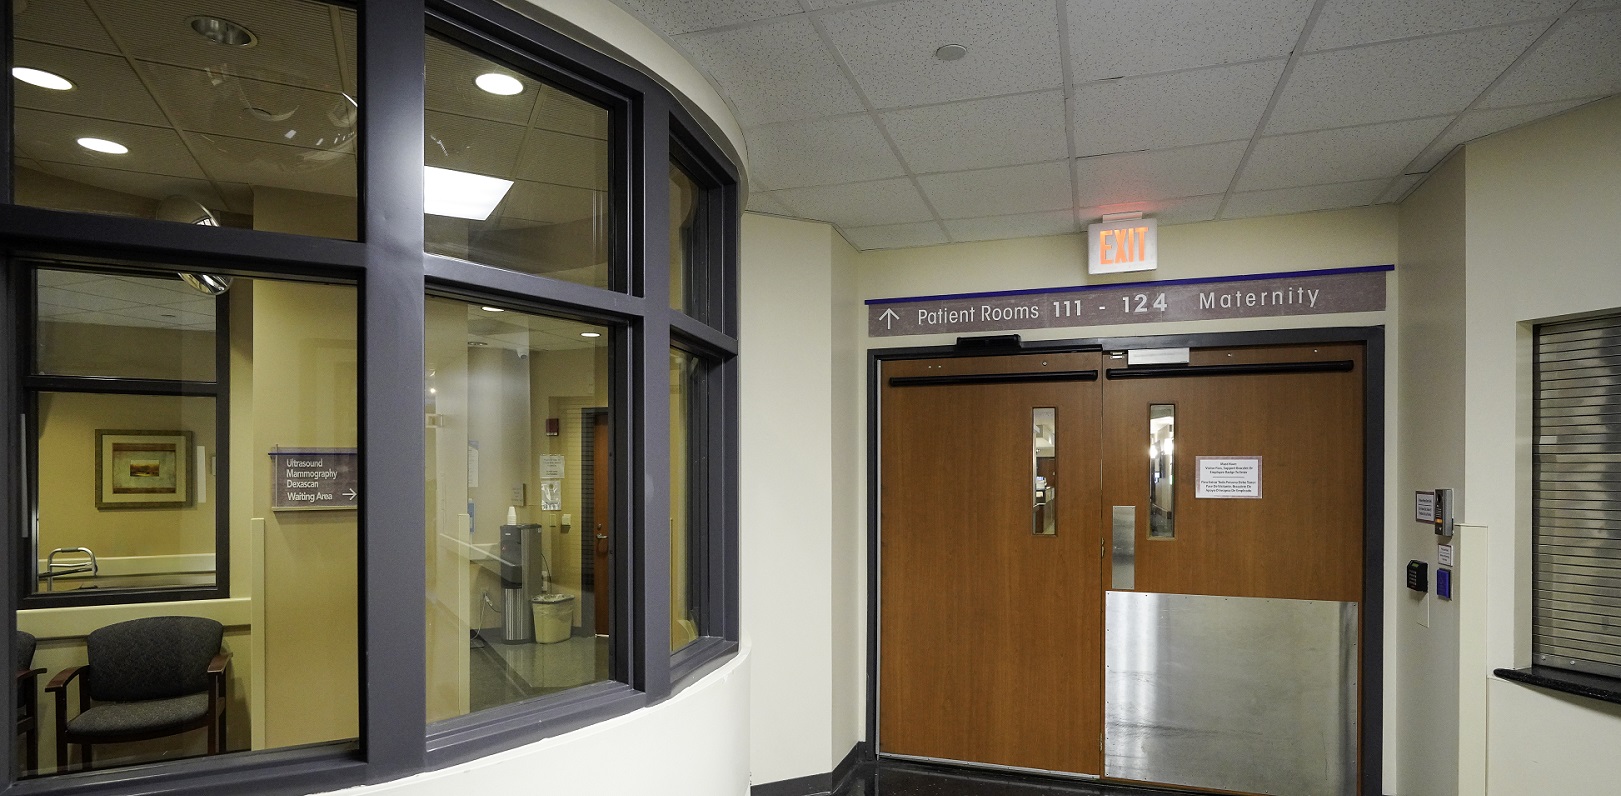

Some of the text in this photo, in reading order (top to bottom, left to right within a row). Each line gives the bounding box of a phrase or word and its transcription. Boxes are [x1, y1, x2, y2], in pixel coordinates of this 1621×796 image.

[1100, 226, 1149, 265] EXIT
[918, 306, 975, 325] Patient
[981, 304, 1039, 322] Rooms
[1053, 300, 1081, 318] 111
[1122, 292, 1168, 313] 124
[1199, 286, 1320, 310] Maternity
[286, 458, 323, 467] Ultrasound
[286, 468, 338, 480] Mammography
[286, 480, 319, 488] Dexascan
[287, 492, 333, 502] Waiting Area
